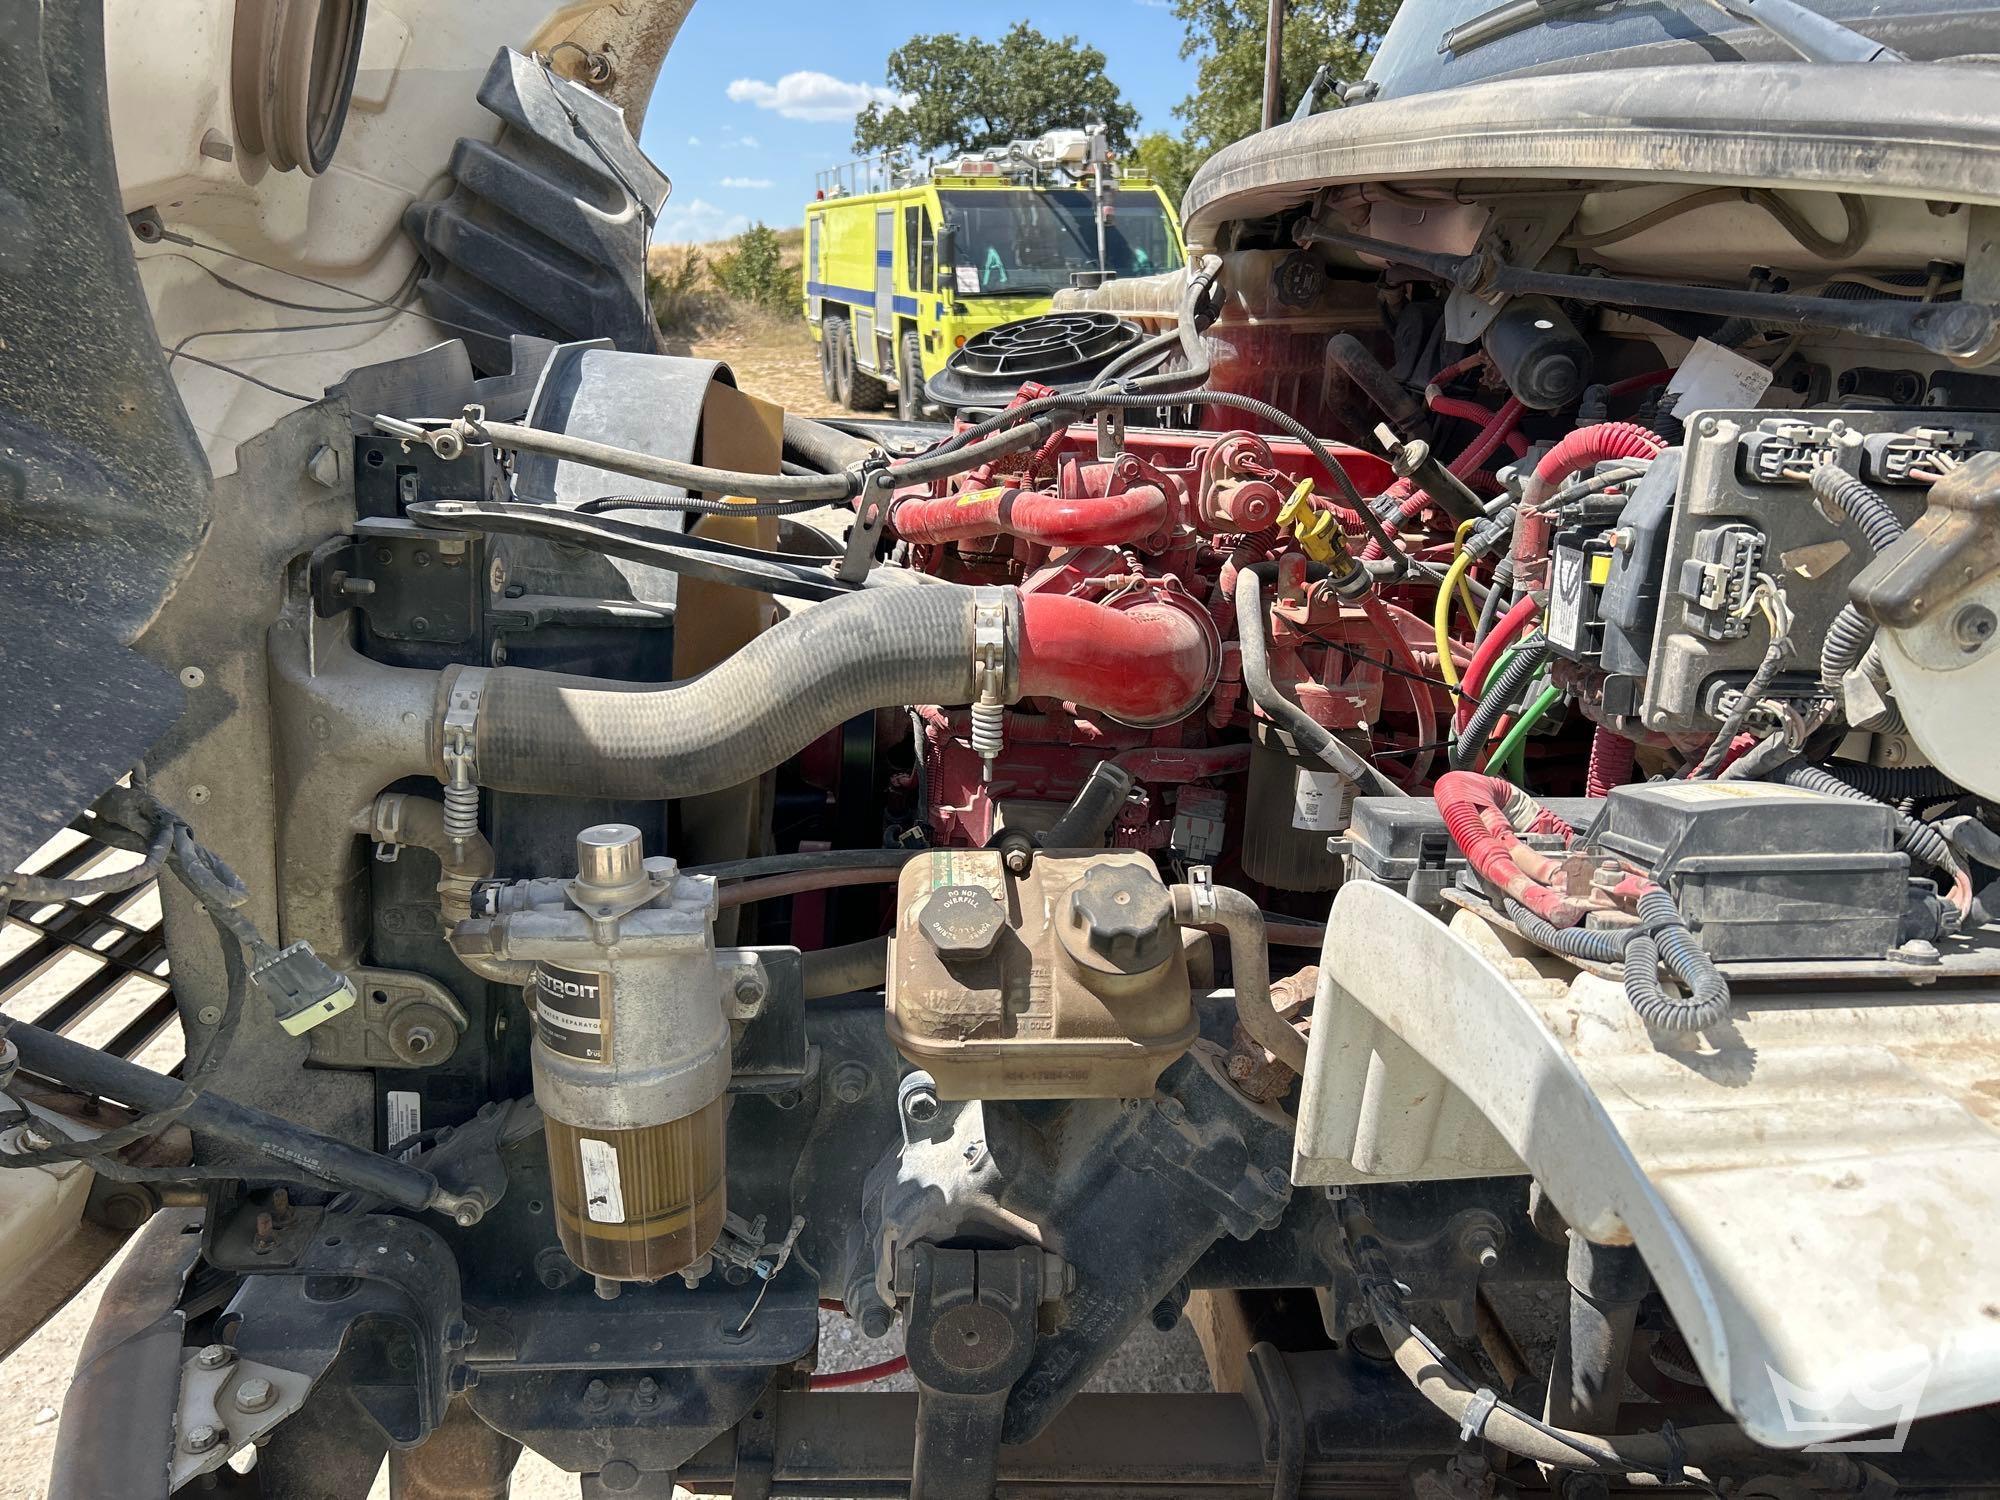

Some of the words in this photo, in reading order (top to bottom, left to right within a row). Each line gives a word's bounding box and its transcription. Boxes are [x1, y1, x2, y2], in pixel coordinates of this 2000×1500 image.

[948, 890, 959, 898] DO
[961, 889, 978, 898] NOT
[943, 896, 979, 908] OVERFILL
